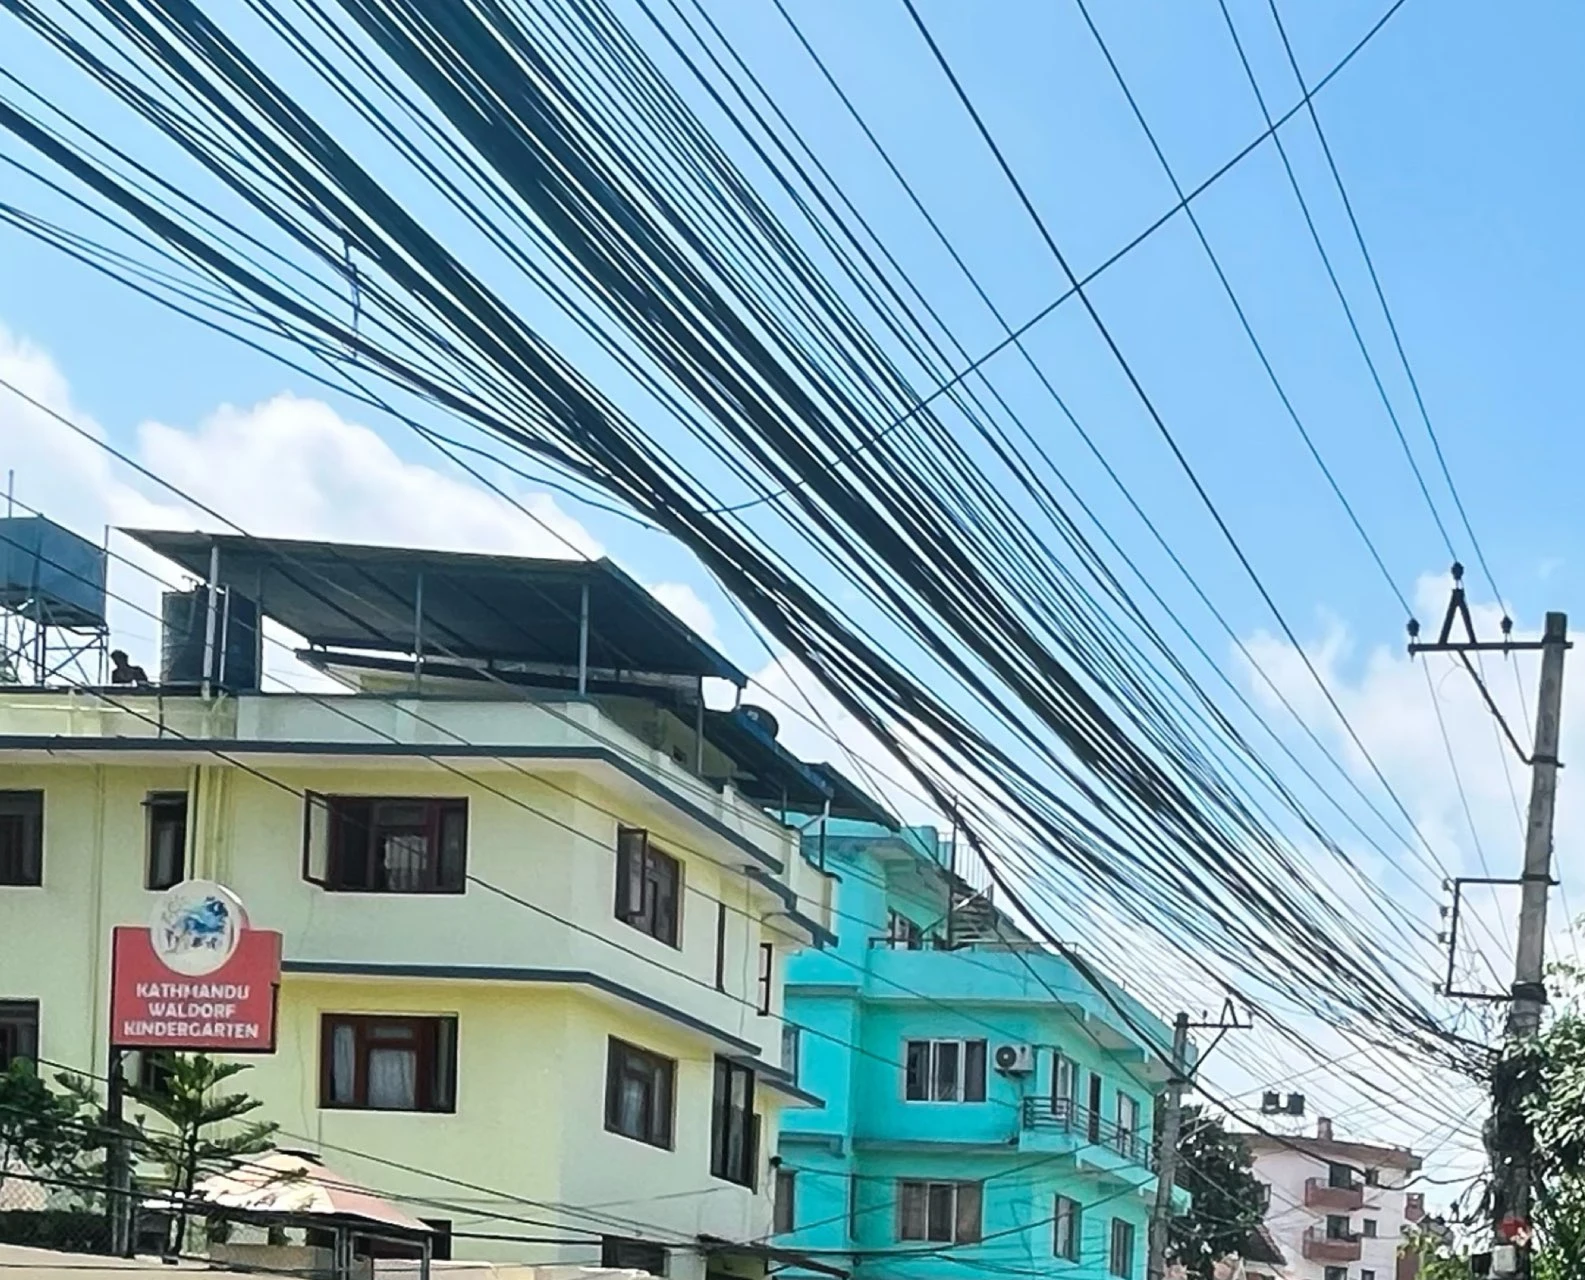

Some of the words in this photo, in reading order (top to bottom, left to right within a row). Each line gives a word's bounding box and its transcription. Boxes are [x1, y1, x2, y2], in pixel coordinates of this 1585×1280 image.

[136, 983, 250, 999] KATHMANDU
[149, 1002, 236, 1019] WALDORF
[124, 1021, 259, 1038] KINDERGARTEN
